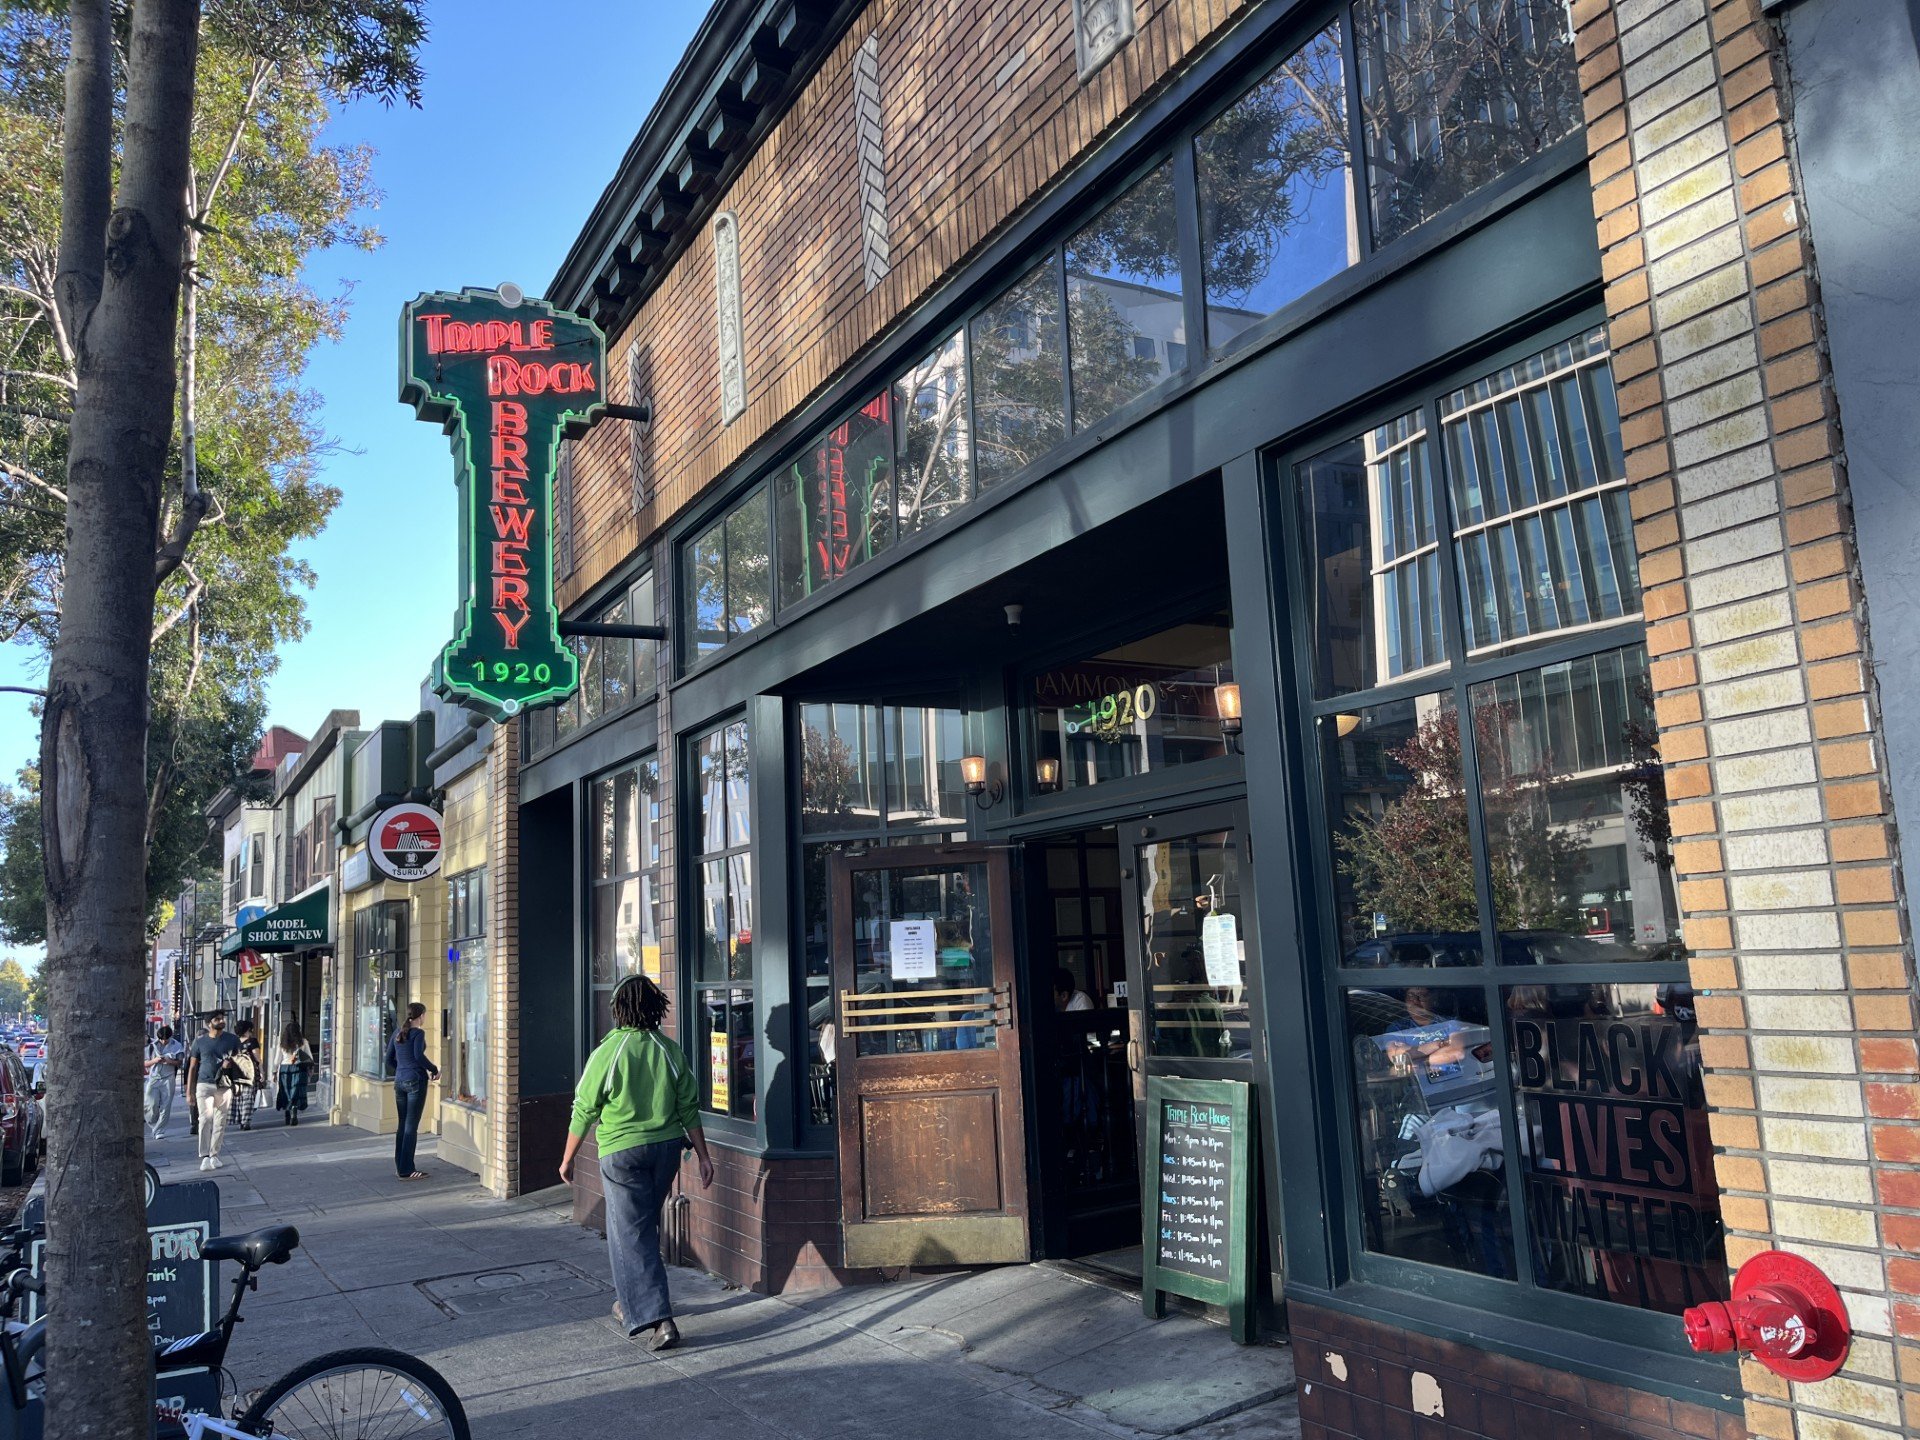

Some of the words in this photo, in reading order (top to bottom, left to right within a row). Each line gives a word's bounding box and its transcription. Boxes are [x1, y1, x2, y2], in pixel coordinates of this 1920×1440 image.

[416, 314, 554, 355] TRIPLE
[487, 355, 596, 396] ROCK
[488, 401, 536, 650] BREWERY
[471, 661, 550, 683] 1920
[1090, 683, 1156, 732] 1920
[392, 868, 428, 876] TSURUYA
[248, 931, 279, 942] SHOE
[282, 929, 323, 941] RENEW
[266, 918, 307, 930] MODEL
[1513, 1020, 1682, 1099] BLACK
[1208, 1136, 1224, 1152] 10pm
[1526, 1099, 1687, 1188] LIVES
[1209, 1158, 1225, 1173] 10pm
[1531, 1179, 1704, 1265] MATTER
[150, 1229, 200, 1261] FOR
[146, 1267, 177, 1282] rink
